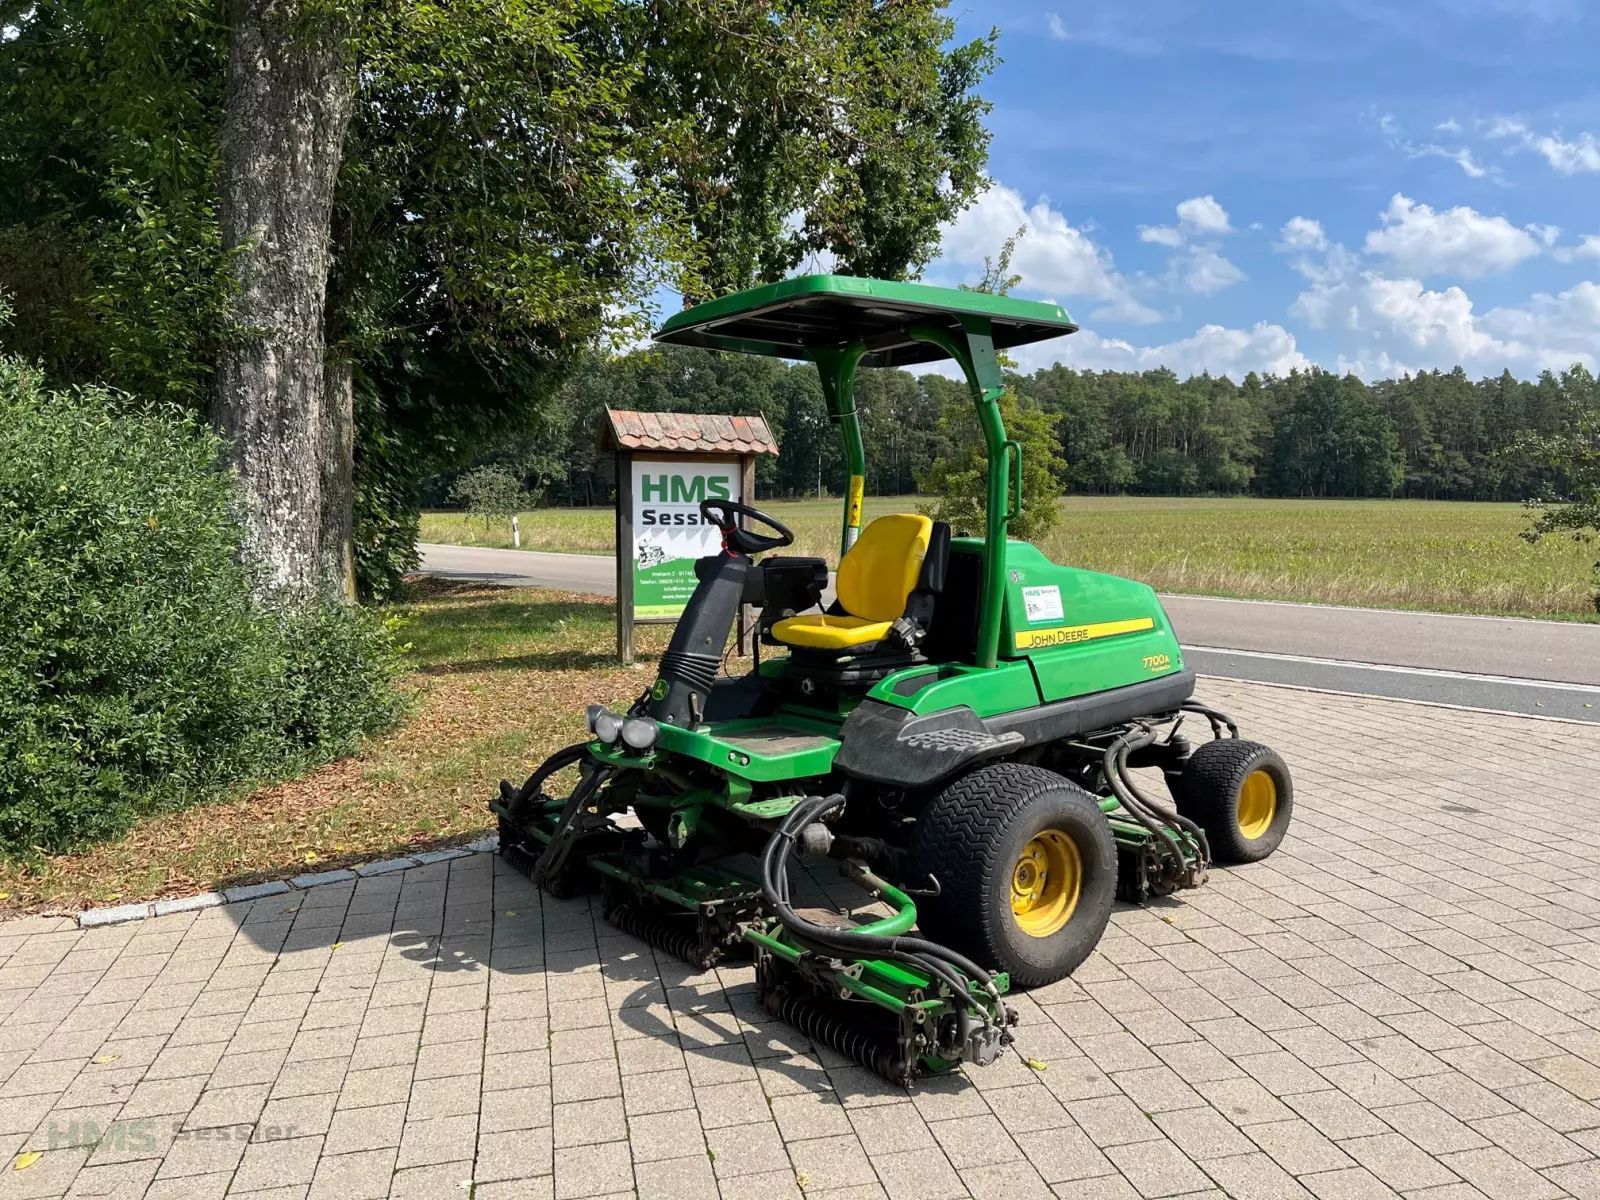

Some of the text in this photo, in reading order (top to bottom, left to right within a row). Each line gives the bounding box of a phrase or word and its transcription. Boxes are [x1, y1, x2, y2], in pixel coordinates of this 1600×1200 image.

[642, 474, 731, 503] HMS
[1028, 629, 1089, 648] JOHN DEERE
[1142, 654, 1170, 669] 7700A
